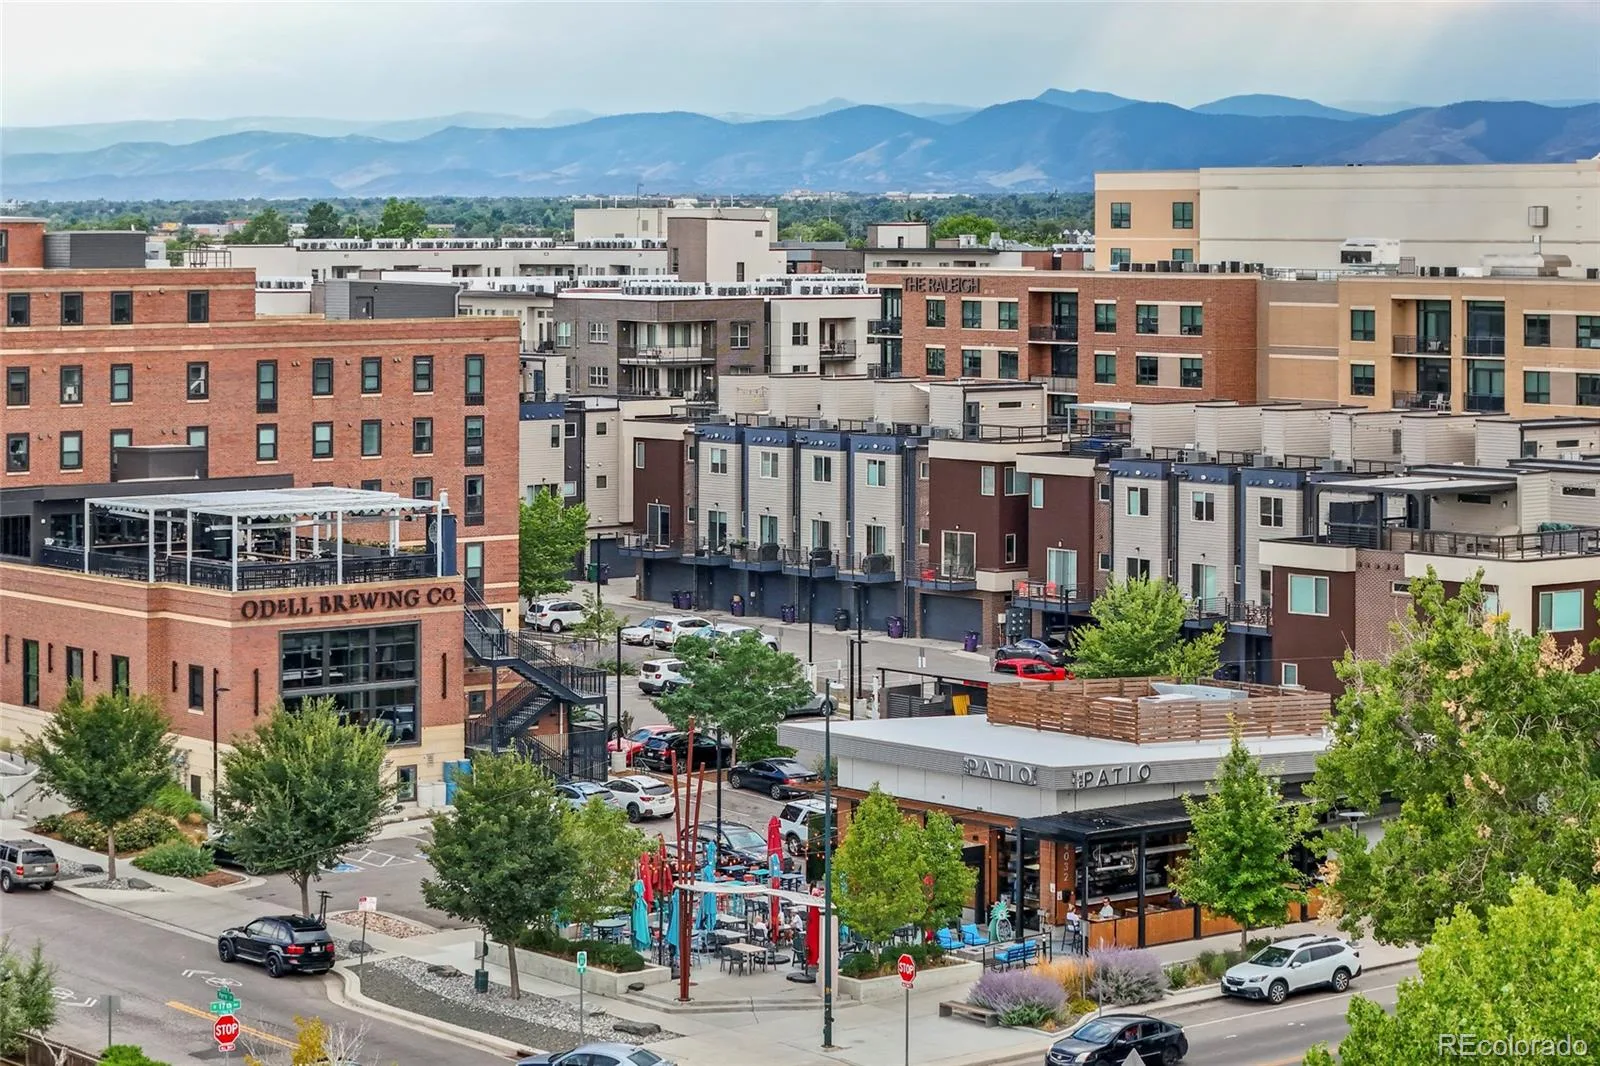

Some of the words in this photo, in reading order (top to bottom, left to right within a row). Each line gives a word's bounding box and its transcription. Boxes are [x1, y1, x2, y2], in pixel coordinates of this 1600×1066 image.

[903, 276, 926, 293] THE
[928, 277, 981, 294] RALEIGH
[240, 596, 313, 619] ODELL
[319, 589, 421, 614] BREWING
[967, 757, 1032, 786] PATIO
[1084, 763, 1151, 788] PATIO
[899, 962, 914, 975] STOP
[215, 1022, 238, 1037] STOP
